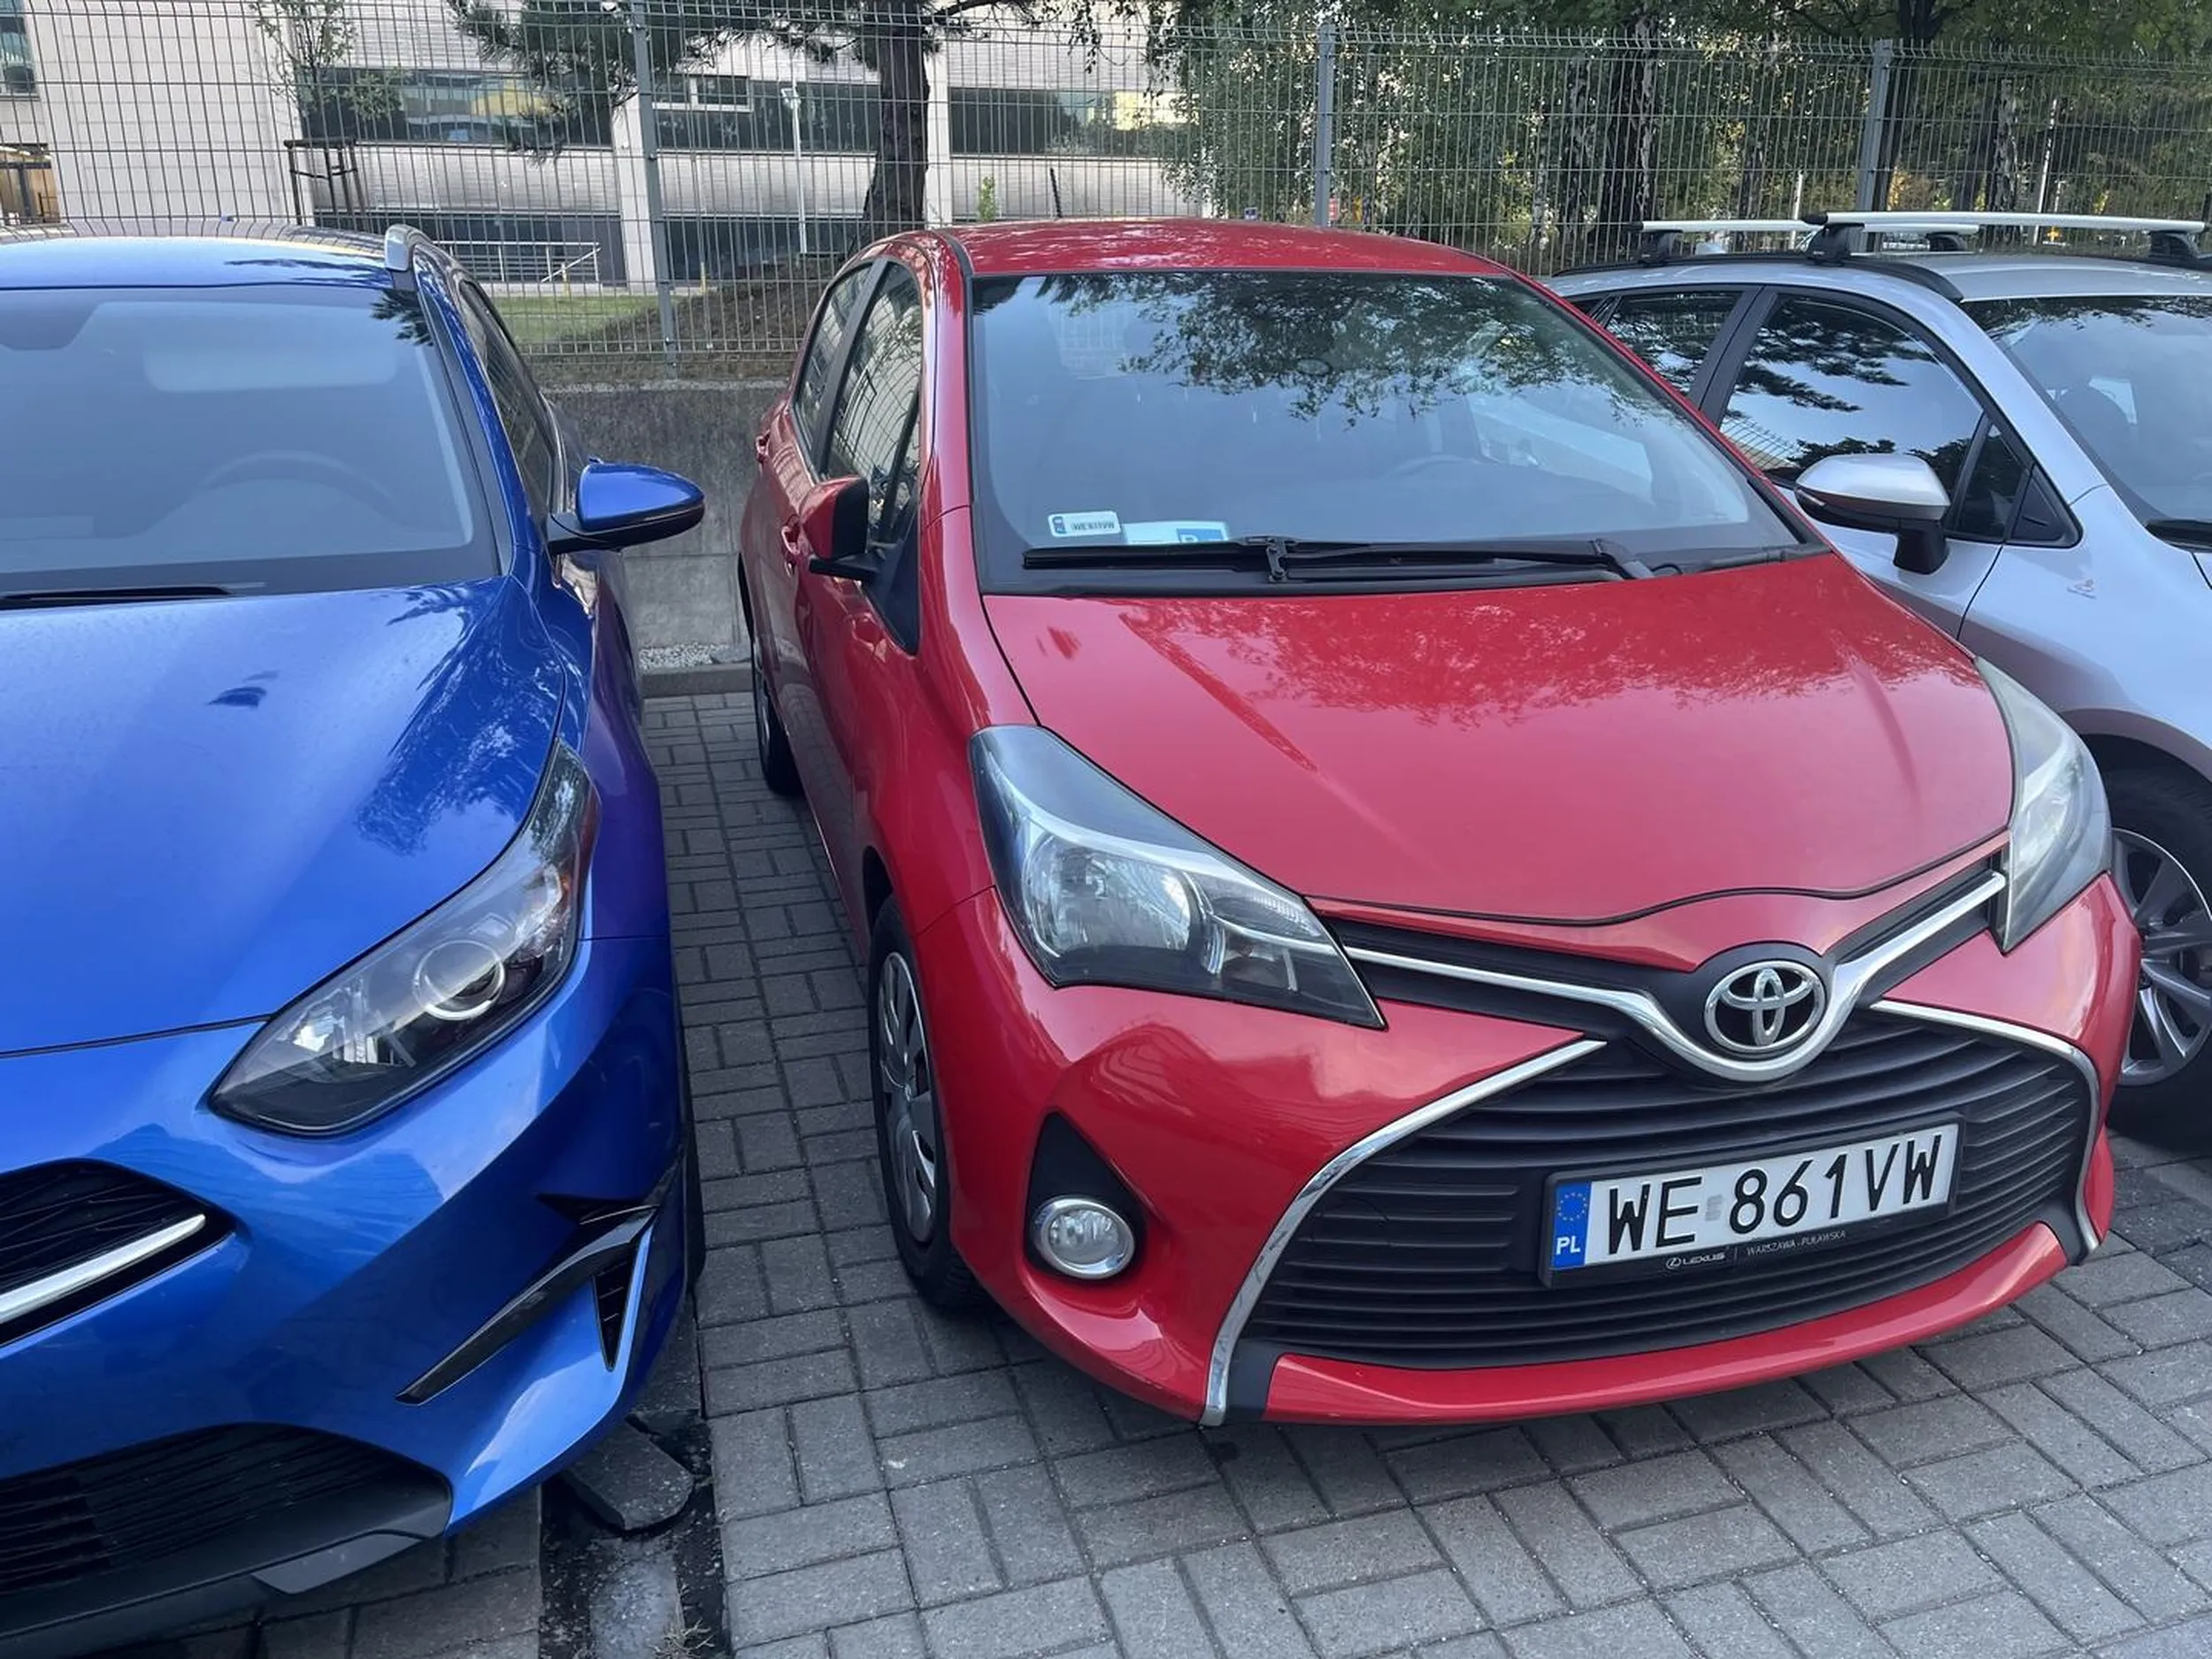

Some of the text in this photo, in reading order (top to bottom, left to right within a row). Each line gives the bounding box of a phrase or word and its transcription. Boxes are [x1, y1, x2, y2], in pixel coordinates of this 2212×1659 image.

[1609, 1133, 1942, 1256] WE 861VW
[1555, 1236, 1581, 1256] PL
[1683, 1252, 1726, 1265] LEXUS
